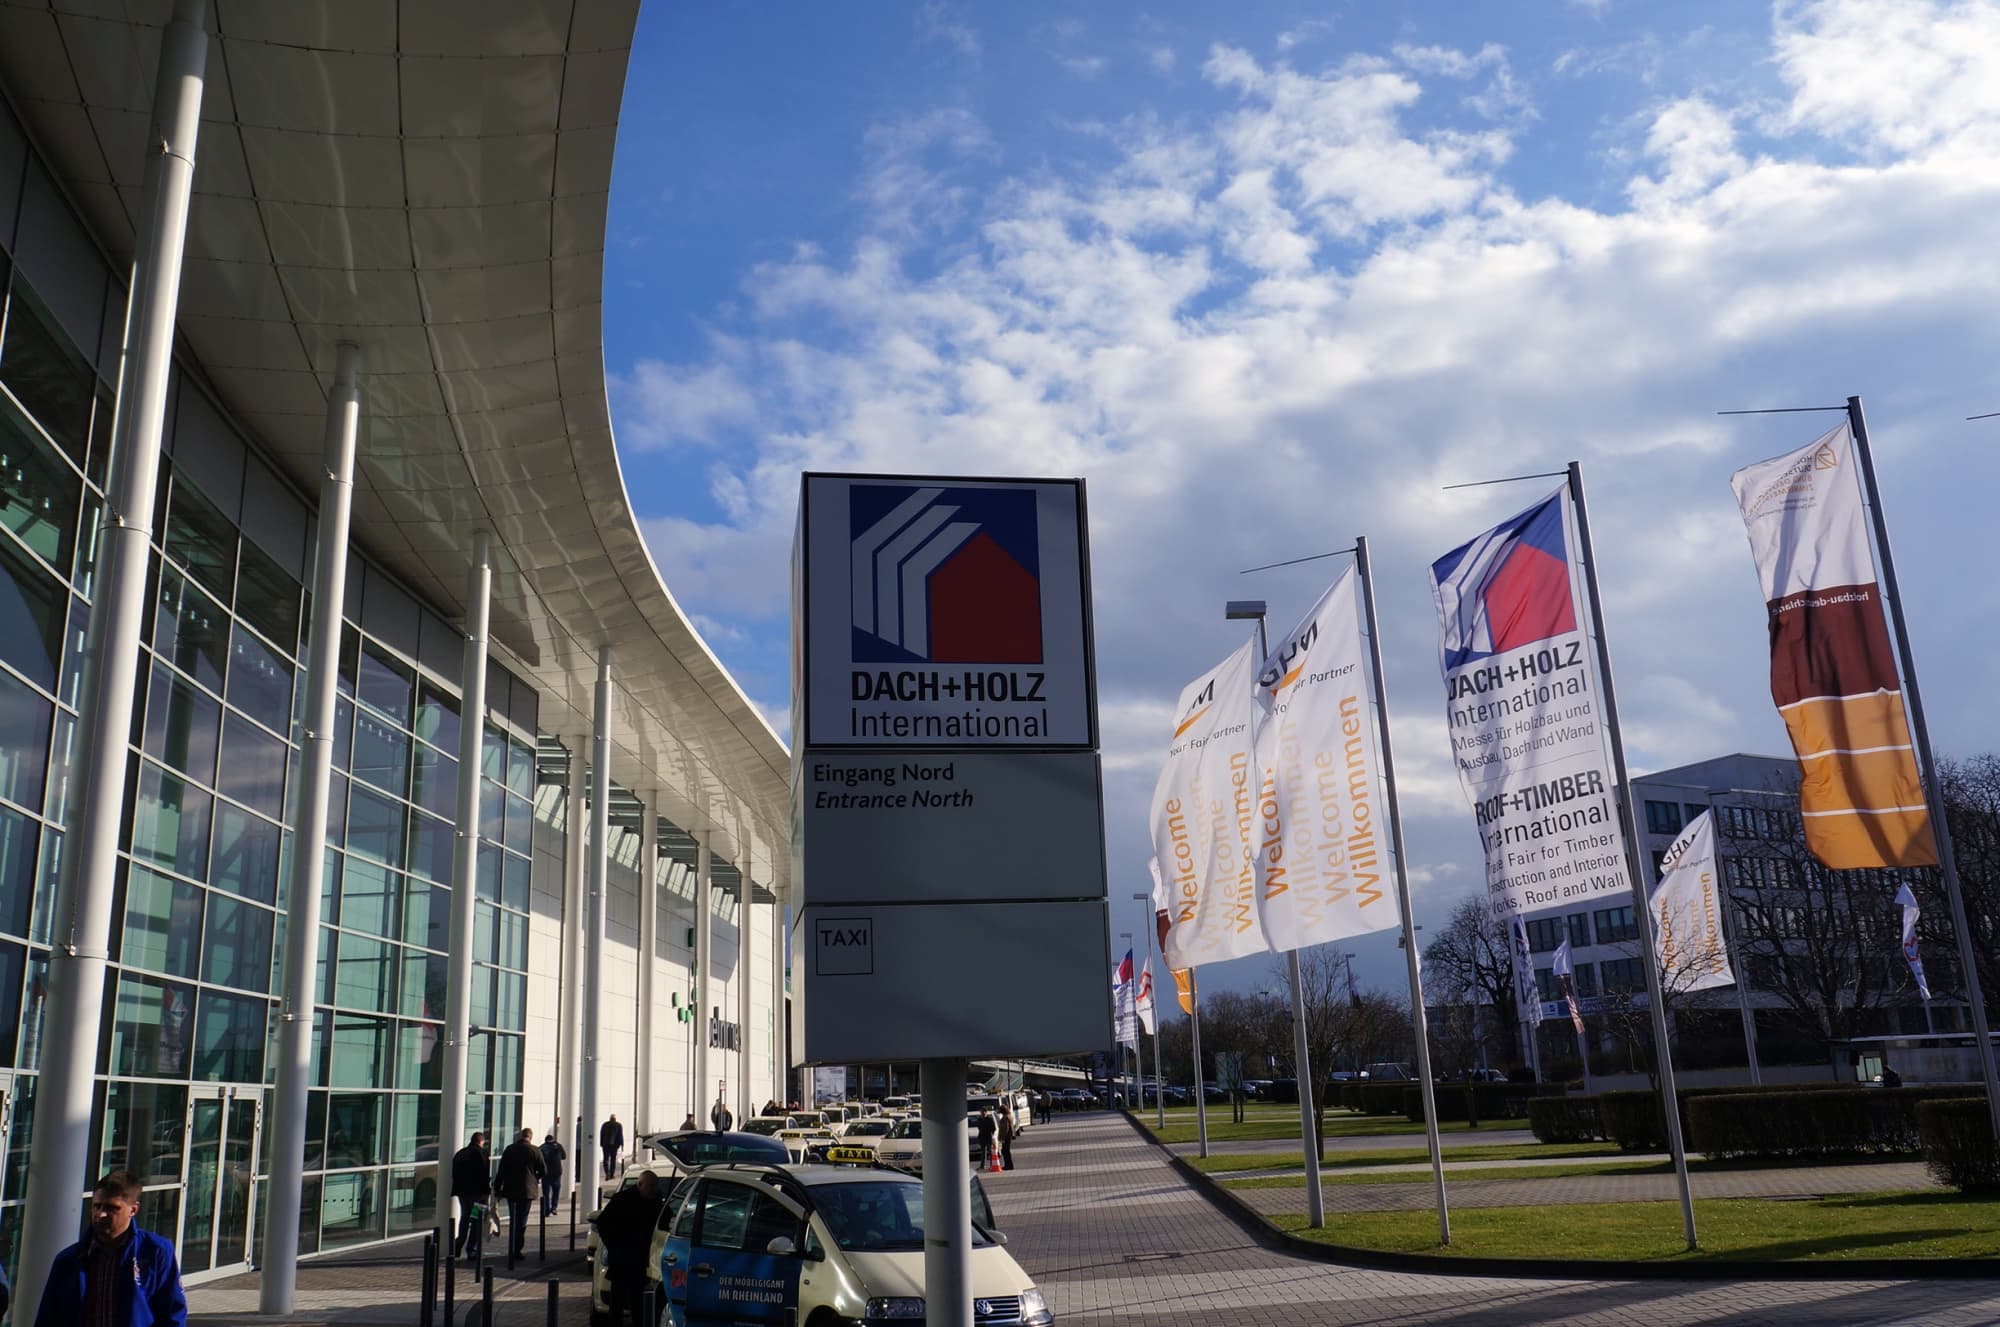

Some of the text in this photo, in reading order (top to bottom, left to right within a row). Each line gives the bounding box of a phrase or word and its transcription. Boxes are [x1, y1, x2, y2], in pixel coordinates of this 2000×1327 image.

[852, 671, 1046, 702] DACH+HOLZ
[1274, 704, 1287, 715] Yo
[1309, 663, 1356, 685] Partner
[1448, 669, 1587, 729] International
[852, 708, 1048, 737] International
[1212, 723, 1246, 740] artner
[1453, 733, 1494, 751] Messe
[1515, 713, 1562, 735] Holzbau
[1565, 701, 1591, 719] und
[1503, 741, 1531, 760] Dach
[1532, 731, 1555, 750] und
[1555, 722, 1594, 742] Wand
[814, 763, 954, 787] Eingang Nord
[815, 789, 974, 809] Entrance North
[1338, 695, 1383, 908] Willkommen
[1474, 769, 1604, 827] ROOF+TIMBER
[1229, 751, 1253, 935] Willkommen
[1313, 750, 1350, 906] Welcome
[1165, 797, 1198, 923] Welcome
[1507, 850, 1536, 867] Fair
[1541, 845, 1560, 860] for
[1564, 833, 1615, 854] Timber
[1549, 861, 1572, 879] and
[1574, 853, 1619, 874] Interior
[1492, 871, 1625, 914] orks, Roof and Wall
[820, 929, 867, 947] TAXI
[841, 1150, 870, 1159] TAXI
[718, 1289, 783, 1303] IM RHEINLAND
